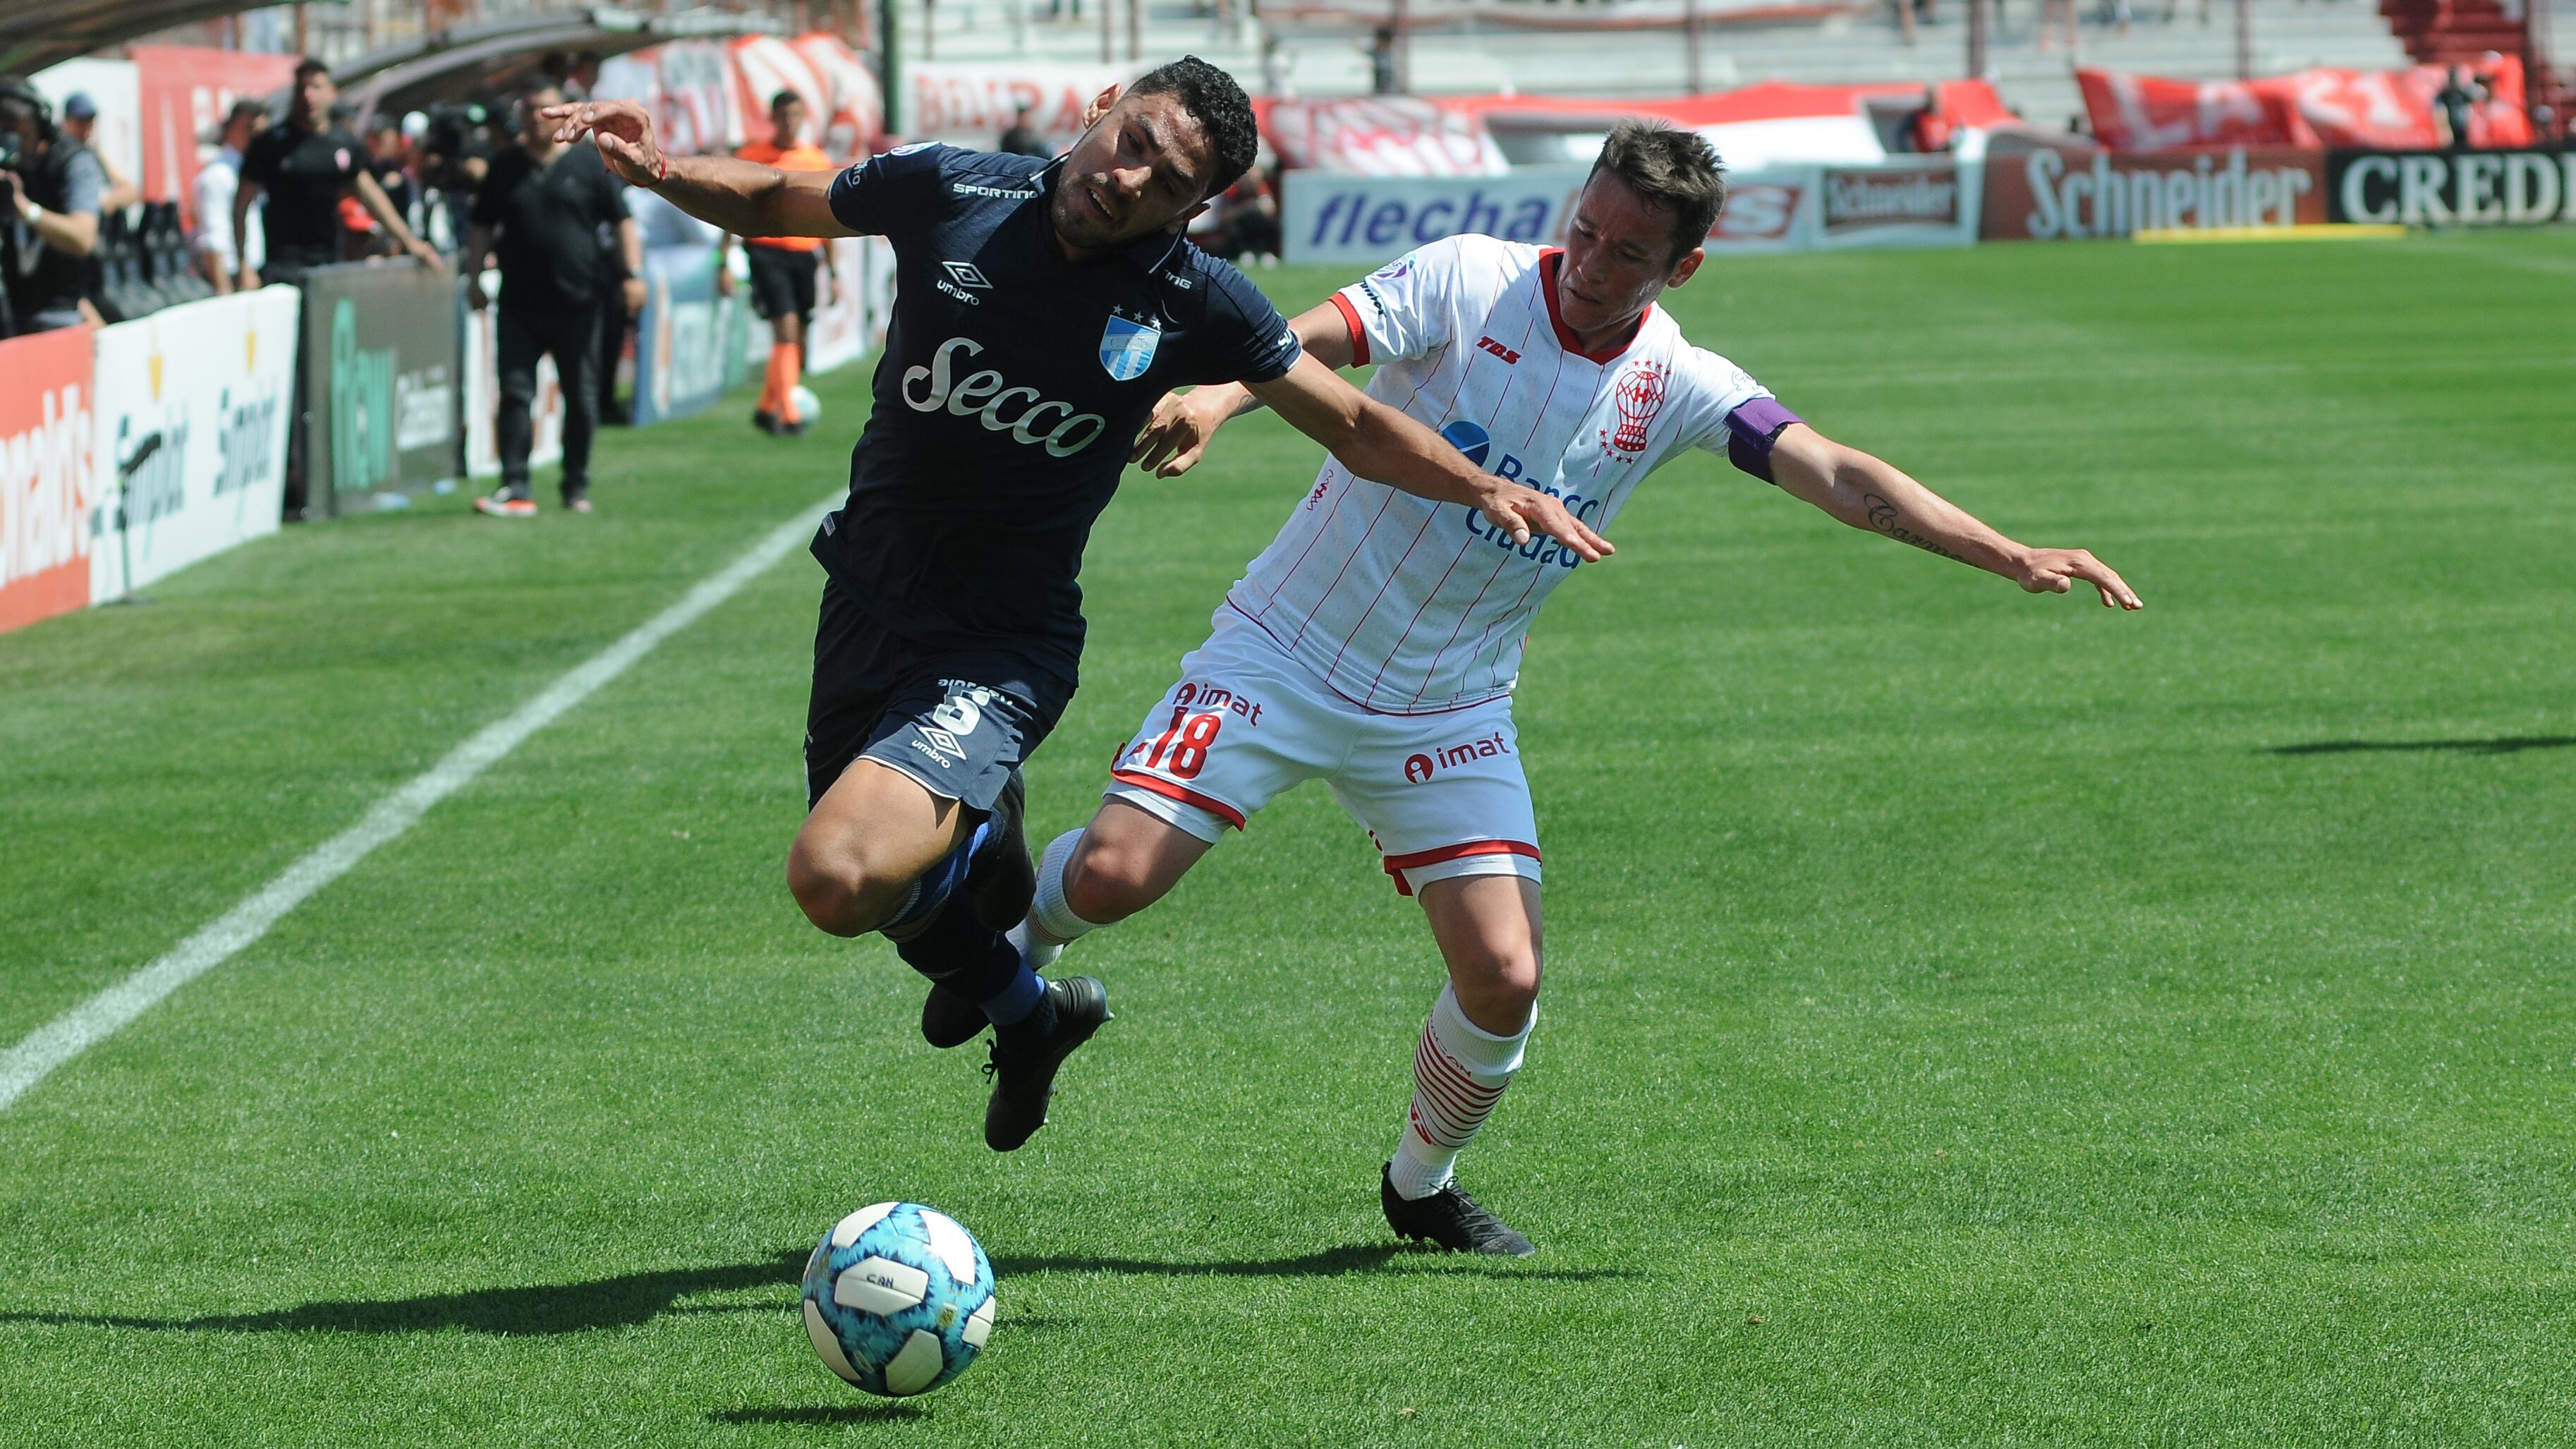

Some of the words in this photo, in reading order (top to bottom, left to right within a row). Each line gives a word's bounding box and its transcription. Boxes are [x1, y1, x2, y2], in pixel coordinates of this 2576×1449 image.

[2027, 147, 2313, 240] Schneider
[937, 279, 980, 306] umbro
[1476, 335, 1522, 365] TBS
[902, 337, 1106, 458] Secco
[911, 739, 952, 769] umbro
[1145, 706, 1222, 780] 18
